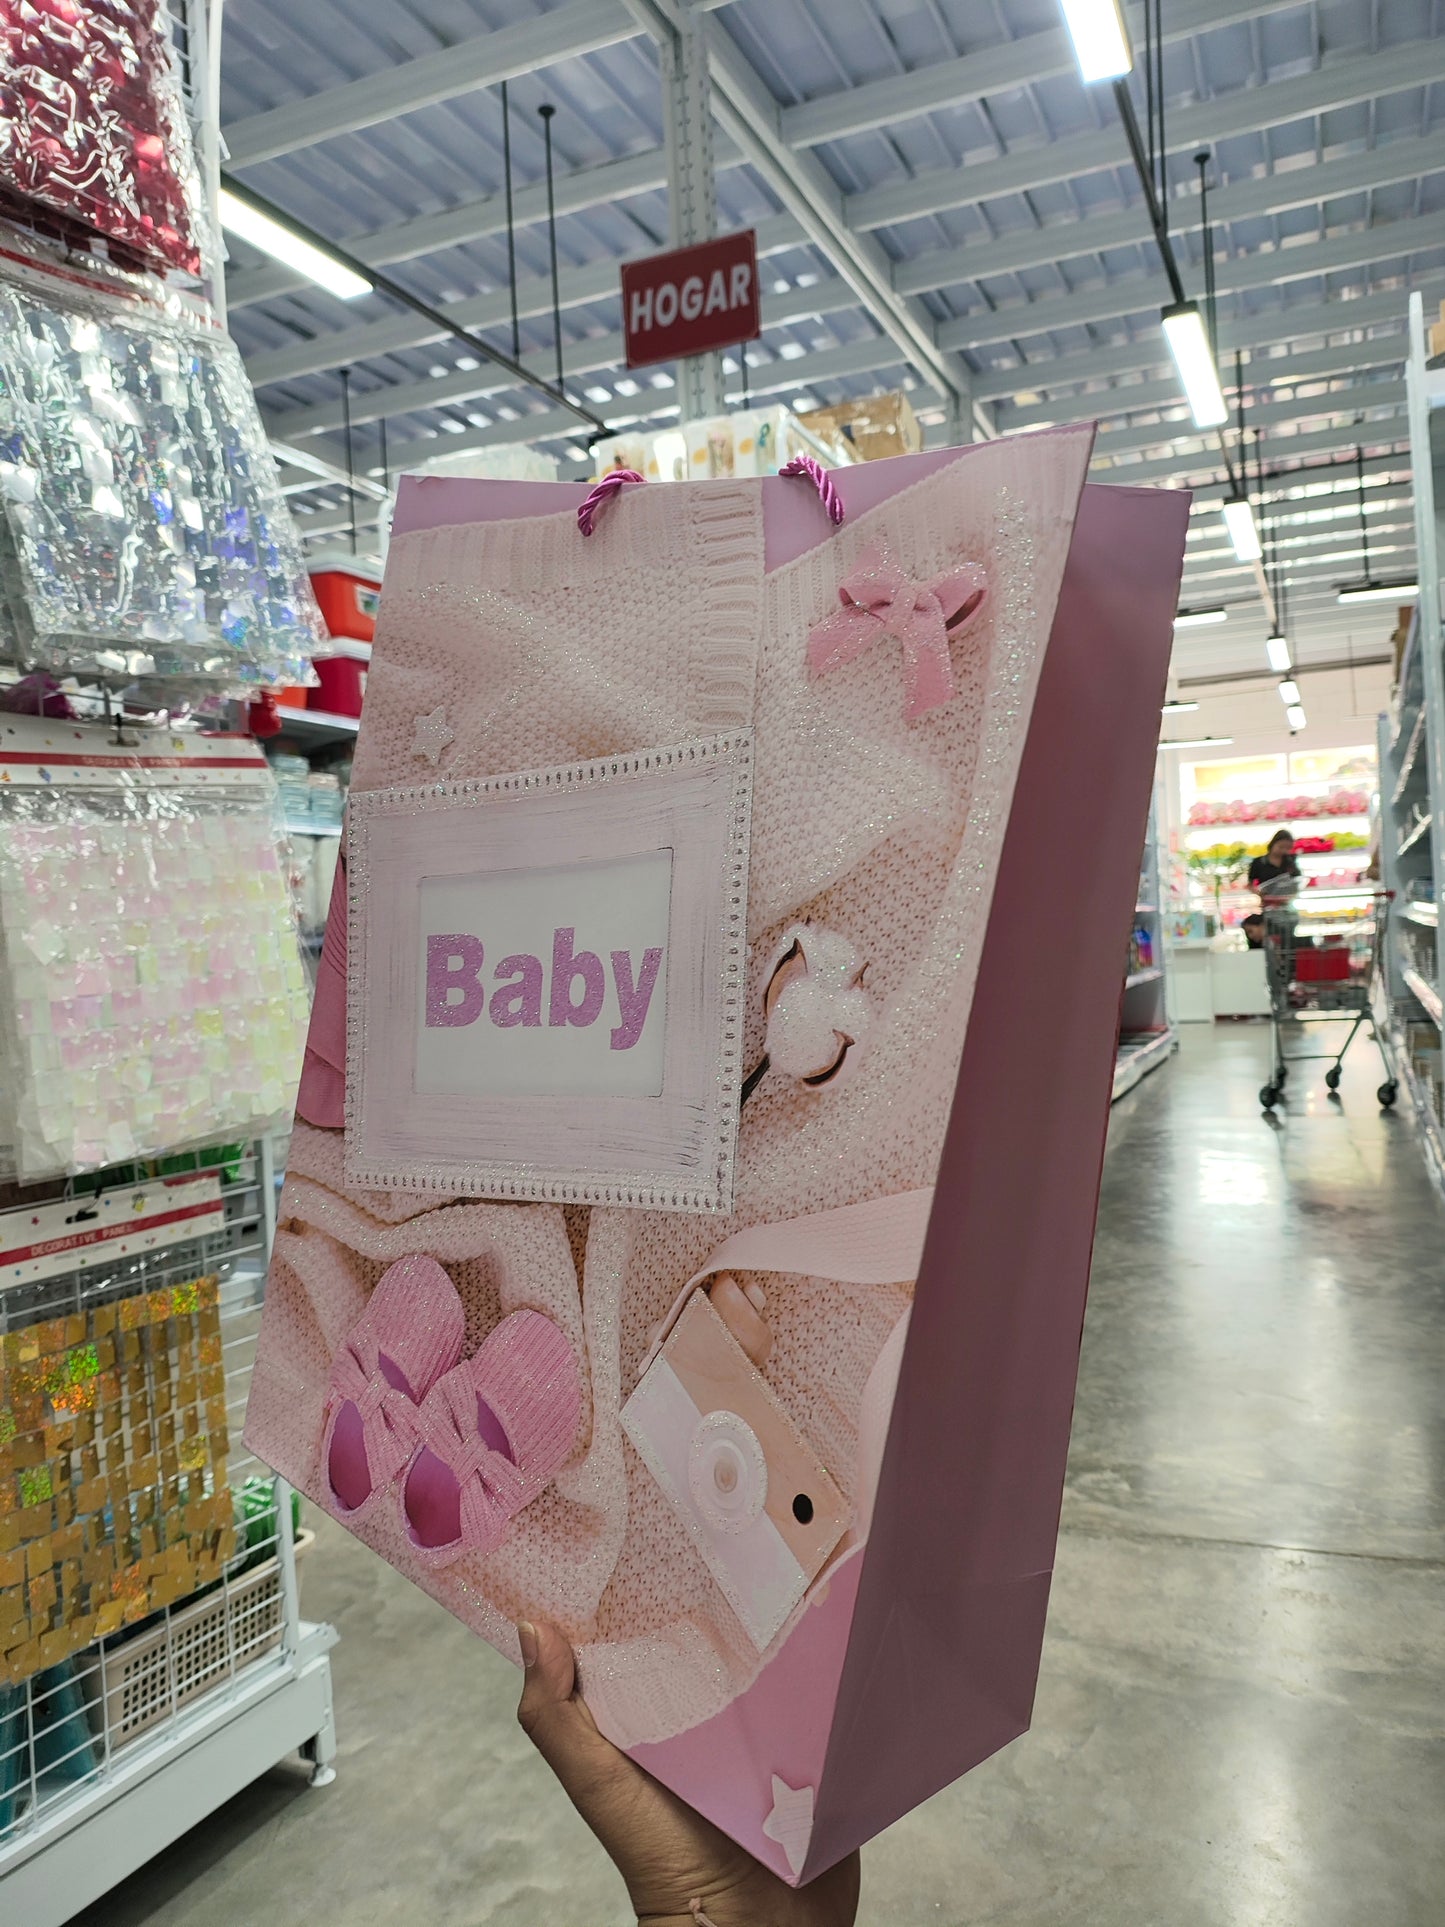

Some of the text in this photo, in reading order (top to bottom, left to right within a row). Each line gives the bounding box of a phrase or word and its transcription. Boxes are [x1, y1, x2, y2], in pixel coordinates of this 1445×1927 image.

[630, 262, 752, 334] HOGAR
[425, 926, 664, 1051] Baby
[30, 1232, 97, 1257] DECORATIVE
